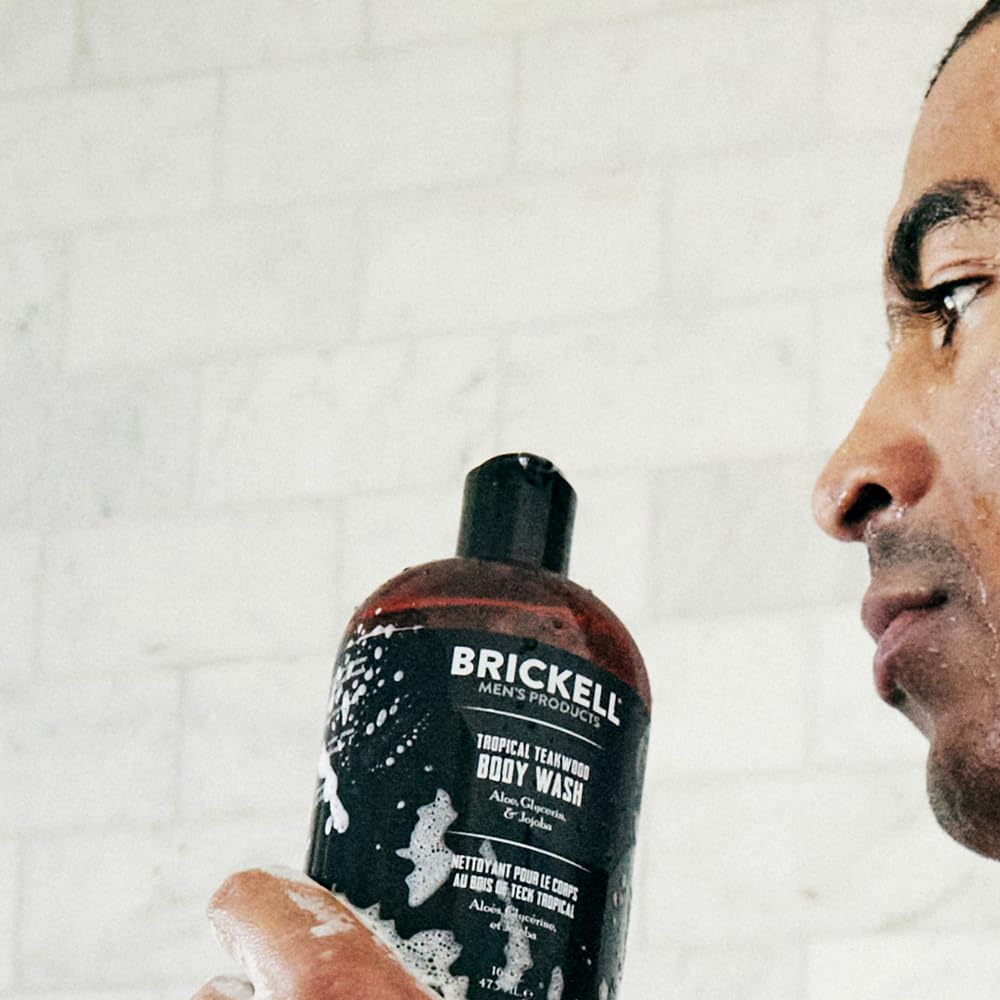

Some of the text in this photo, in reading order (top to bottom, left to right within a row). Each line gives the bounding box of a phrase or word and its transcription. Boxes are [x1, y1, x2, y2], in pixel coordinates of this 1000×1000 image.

[451, 646, 620, 726] BRICKELL
[478, 681, 600, 728] MEN'S PRODUCTS
[477, 733, 590, 781] TROPICAL TEAKWOOD
[477, 753, 584, 807] BODY WASH
[503, 807, 552, 832] & Jojoba
[451, 854, 579, 902] NETTOYANT POUR LE CORPS
[452, 872, 469, 889] AU
[469, 875, 494, 893] BOIS
[511, 883, 536, 904] TECK
[536, 891, 576, 920] TROPICAL
